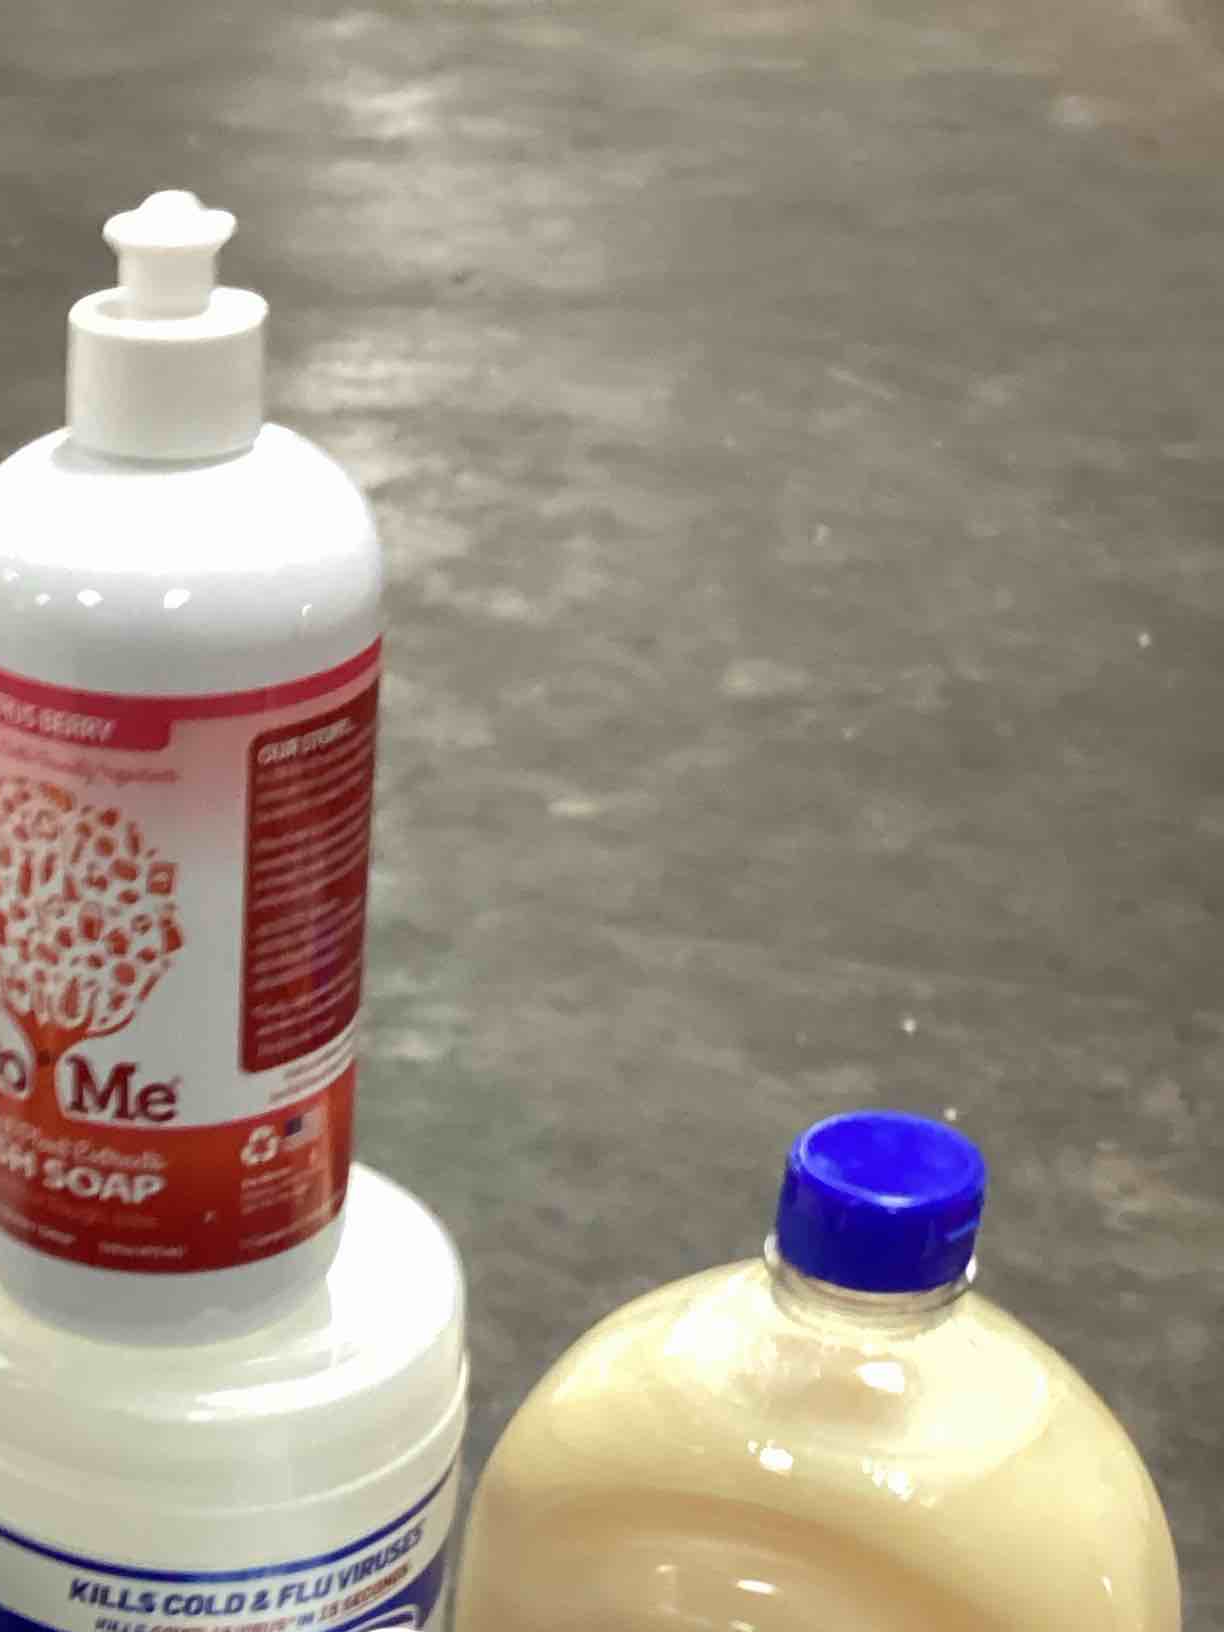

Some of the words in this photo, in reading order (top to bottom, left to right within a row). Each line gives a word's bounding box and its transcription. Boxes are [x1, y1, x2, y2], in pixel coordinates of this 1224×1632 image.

[39, 708, 119, 743] BERRY
[66, 1054, 178, 1123] Me
[42, 1158, 166, 1204] SOAP
[68, 1577, 156, 1615] KILLS
[161, 1592, 246, 1616] COLD
[249, 1590, 272, 1612] &
[276, 1576, 336, 1609] FLU
[336, 1524, 425, 1592] VIRUSES
